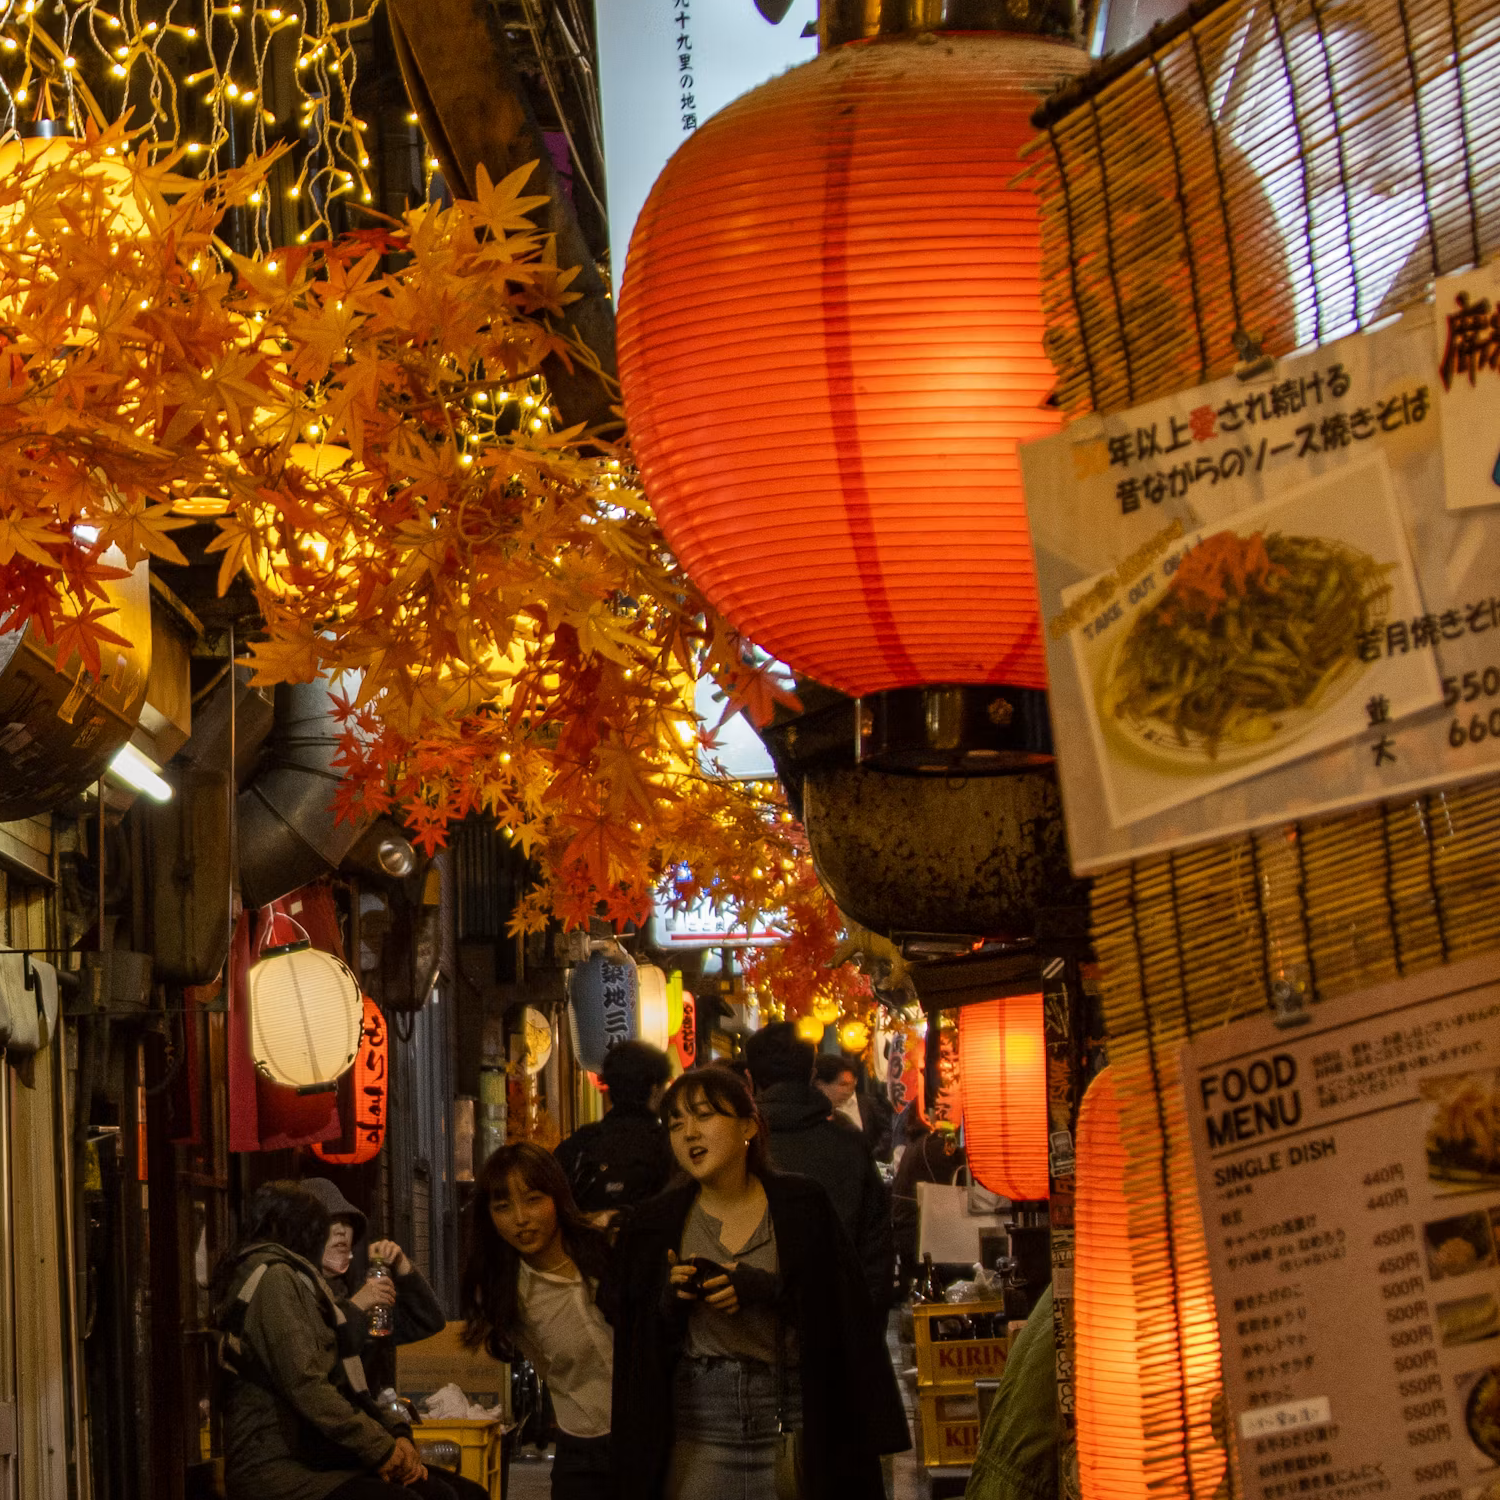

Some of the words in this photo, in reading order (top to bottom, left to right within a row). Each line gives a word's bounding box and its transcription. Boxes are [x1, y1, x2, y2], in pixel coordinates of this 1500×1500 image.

[1107, 364, 1351, 468] 年以上愛され続ける
[1116, 385, 1430, 514] 昔ながらのソース焼きそば
[1082, 600, 1124, 641] TAKE
[1128, 572, 1156, 605] OUT
[1371, 734, 1397, 768] 大
[1200, 1052, 1297, 1112] FOOD
[1205, 1089, 1301, 1151] MENU
[1213, 1152, 1282, 1188] SINGLE
[1289, 1136, 1337, 1167] DISH
[1363, 1162, 1404, 1188] 440円
[1366, 1187, 1409, 1211] 440円
[1373, 1223, 1416, 1248] 450円
[1378, 1251, 1421, 1275] 450円
[1382, 1276, 1425, 1300] 500円
[1386, 1300, 1429, 1325] 500円
[1390, 1324, 1434, 1349] 500円
[938, 1344, 1009, 1368] KIRIN
[1394, 1348, 1438, 1374] 500円
[1399, 1373, 1443, 1399] 550円
[1403, 1397, 1448, 1423] 550円
[1407, 1422, 1452, 1447] 550円
[1414, 1459, 1459, 1484] 550円
